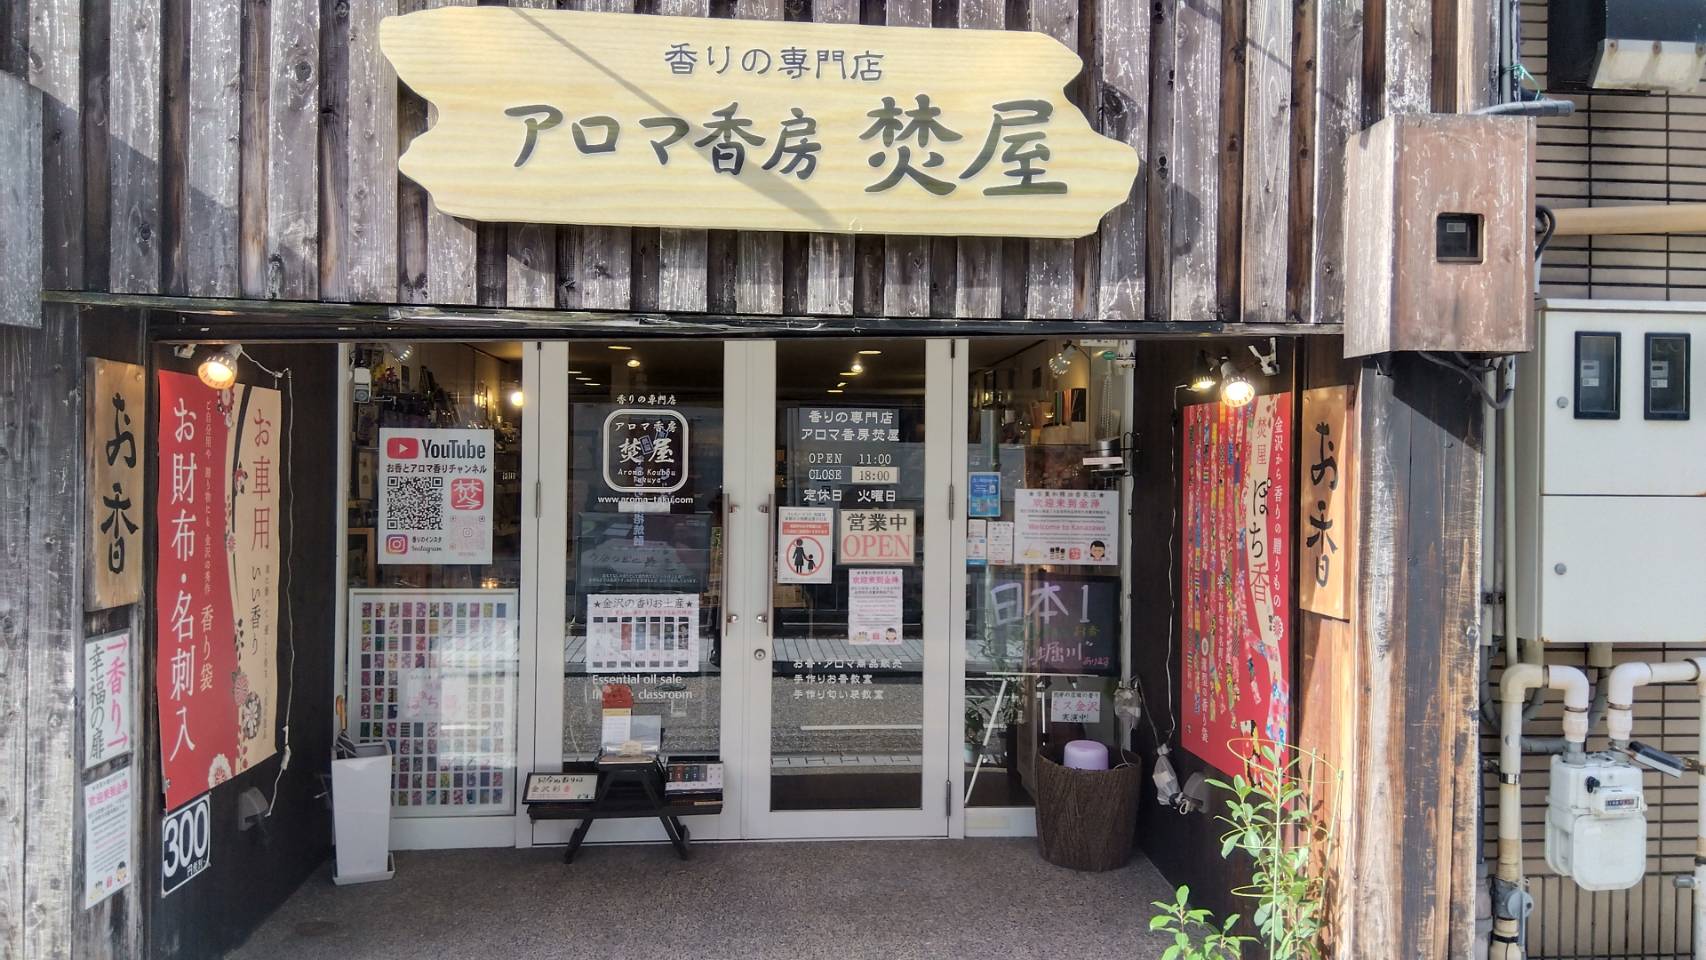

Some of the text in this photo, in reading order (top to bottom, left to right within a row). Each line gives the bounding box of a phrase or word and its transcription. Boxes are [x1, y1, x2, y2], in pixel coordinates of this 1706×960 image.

[664, 43, 886, 82] 香りの専門店
[503, 94, 1068, 196] アロマ香房 焚屋
[616, 394, 677, 406] 香りの専門店
[808, 410, 894, 424] 香りの専門店
[614, 421, 678, 433] アロマ香房
[801, 428, 900, 441] アロマ香房焚屋
[422, 439, 486, 459] YouTube
[618, 437, 675, 464] 焚屋
[808, 453, 892, 465] OPEN 11:00
[386, 464, 487, 474] お香とアロマ香りチャンネル
[618, 468, 645, 477] Aroma
[808, 469, 890, 481] CLOSE 18:00
[100, 391, 140, 574] お香
[251, 408, 271, 550] お車用
[597, 495, 694, 505] www.aroma-taku.com
[803, 489, 896, 502] 定休日 火曜日
[1306, 421, 1339, 588] お香
[847, 513, 908, 532] 営業中
[843, 534, 912, 558] OPEN
[170, 397, 198, 762] お財布・名刺入
[250, 565, 264, 656] いい香り
[603, 598, 685, 609] 金沢の香りお土産
[200, 604, 214, 691] 香り袋
[592, 674, 683, 685] Essential oil sale
[793, 674, 872, 685] 手作りお香教室
[89, 643, 107, 760] 幸福の扉
[106, 656, 127, 735] 香り
[638, 688, 693, 700] classroom
[163, 802, 209, 878] 300
